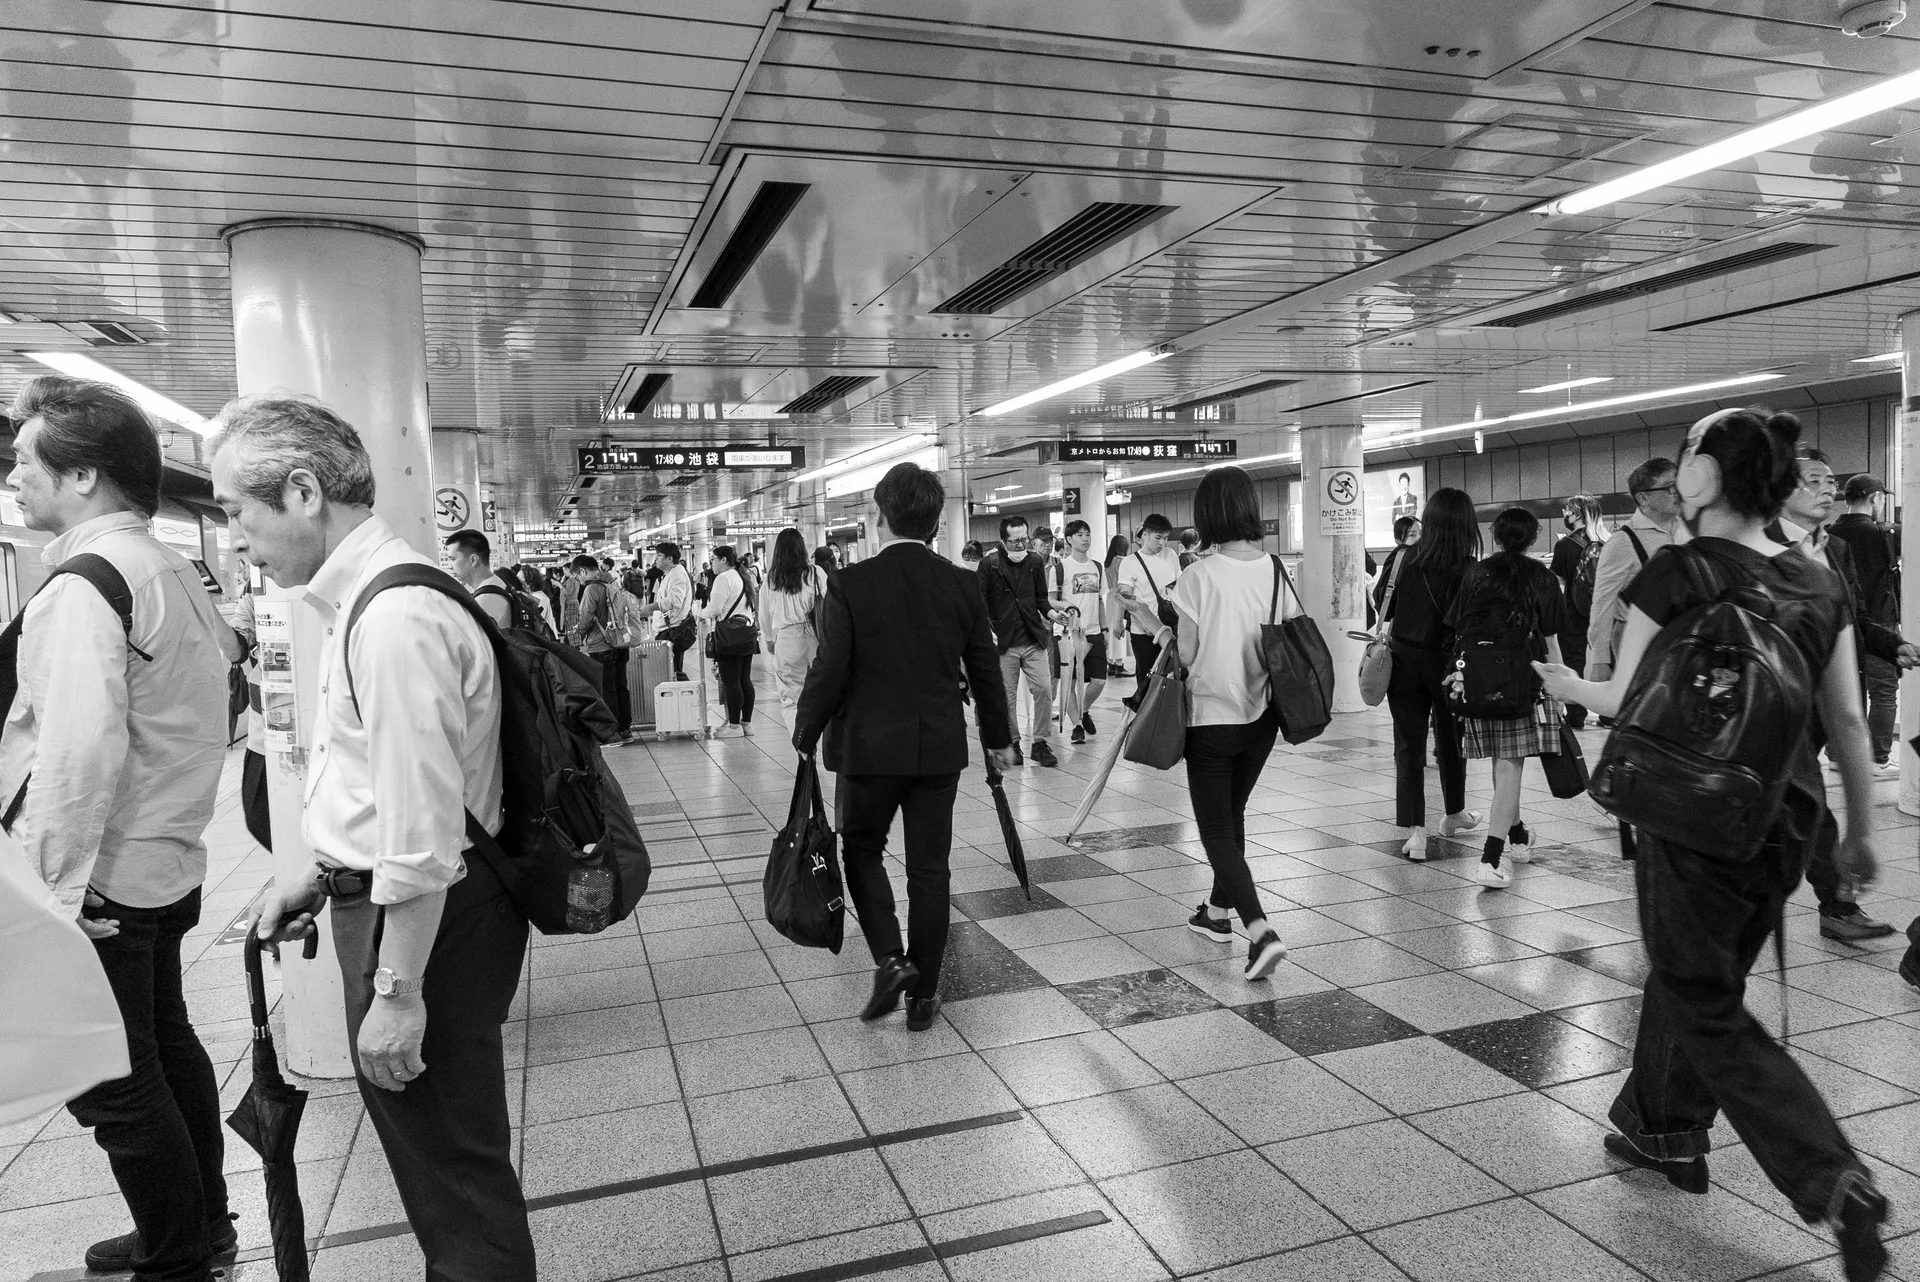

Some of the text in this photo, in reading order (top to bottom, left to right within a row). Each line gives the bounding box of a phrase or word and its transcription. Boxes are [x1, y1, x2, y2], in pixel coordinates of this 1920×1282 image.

[1225, 441, 1230, 453] 1
[584, 454, 595, 469] 2
[688, 452, 719, 466] 池袋
[1322, 508, 1362, 517] かけこみ禁止
